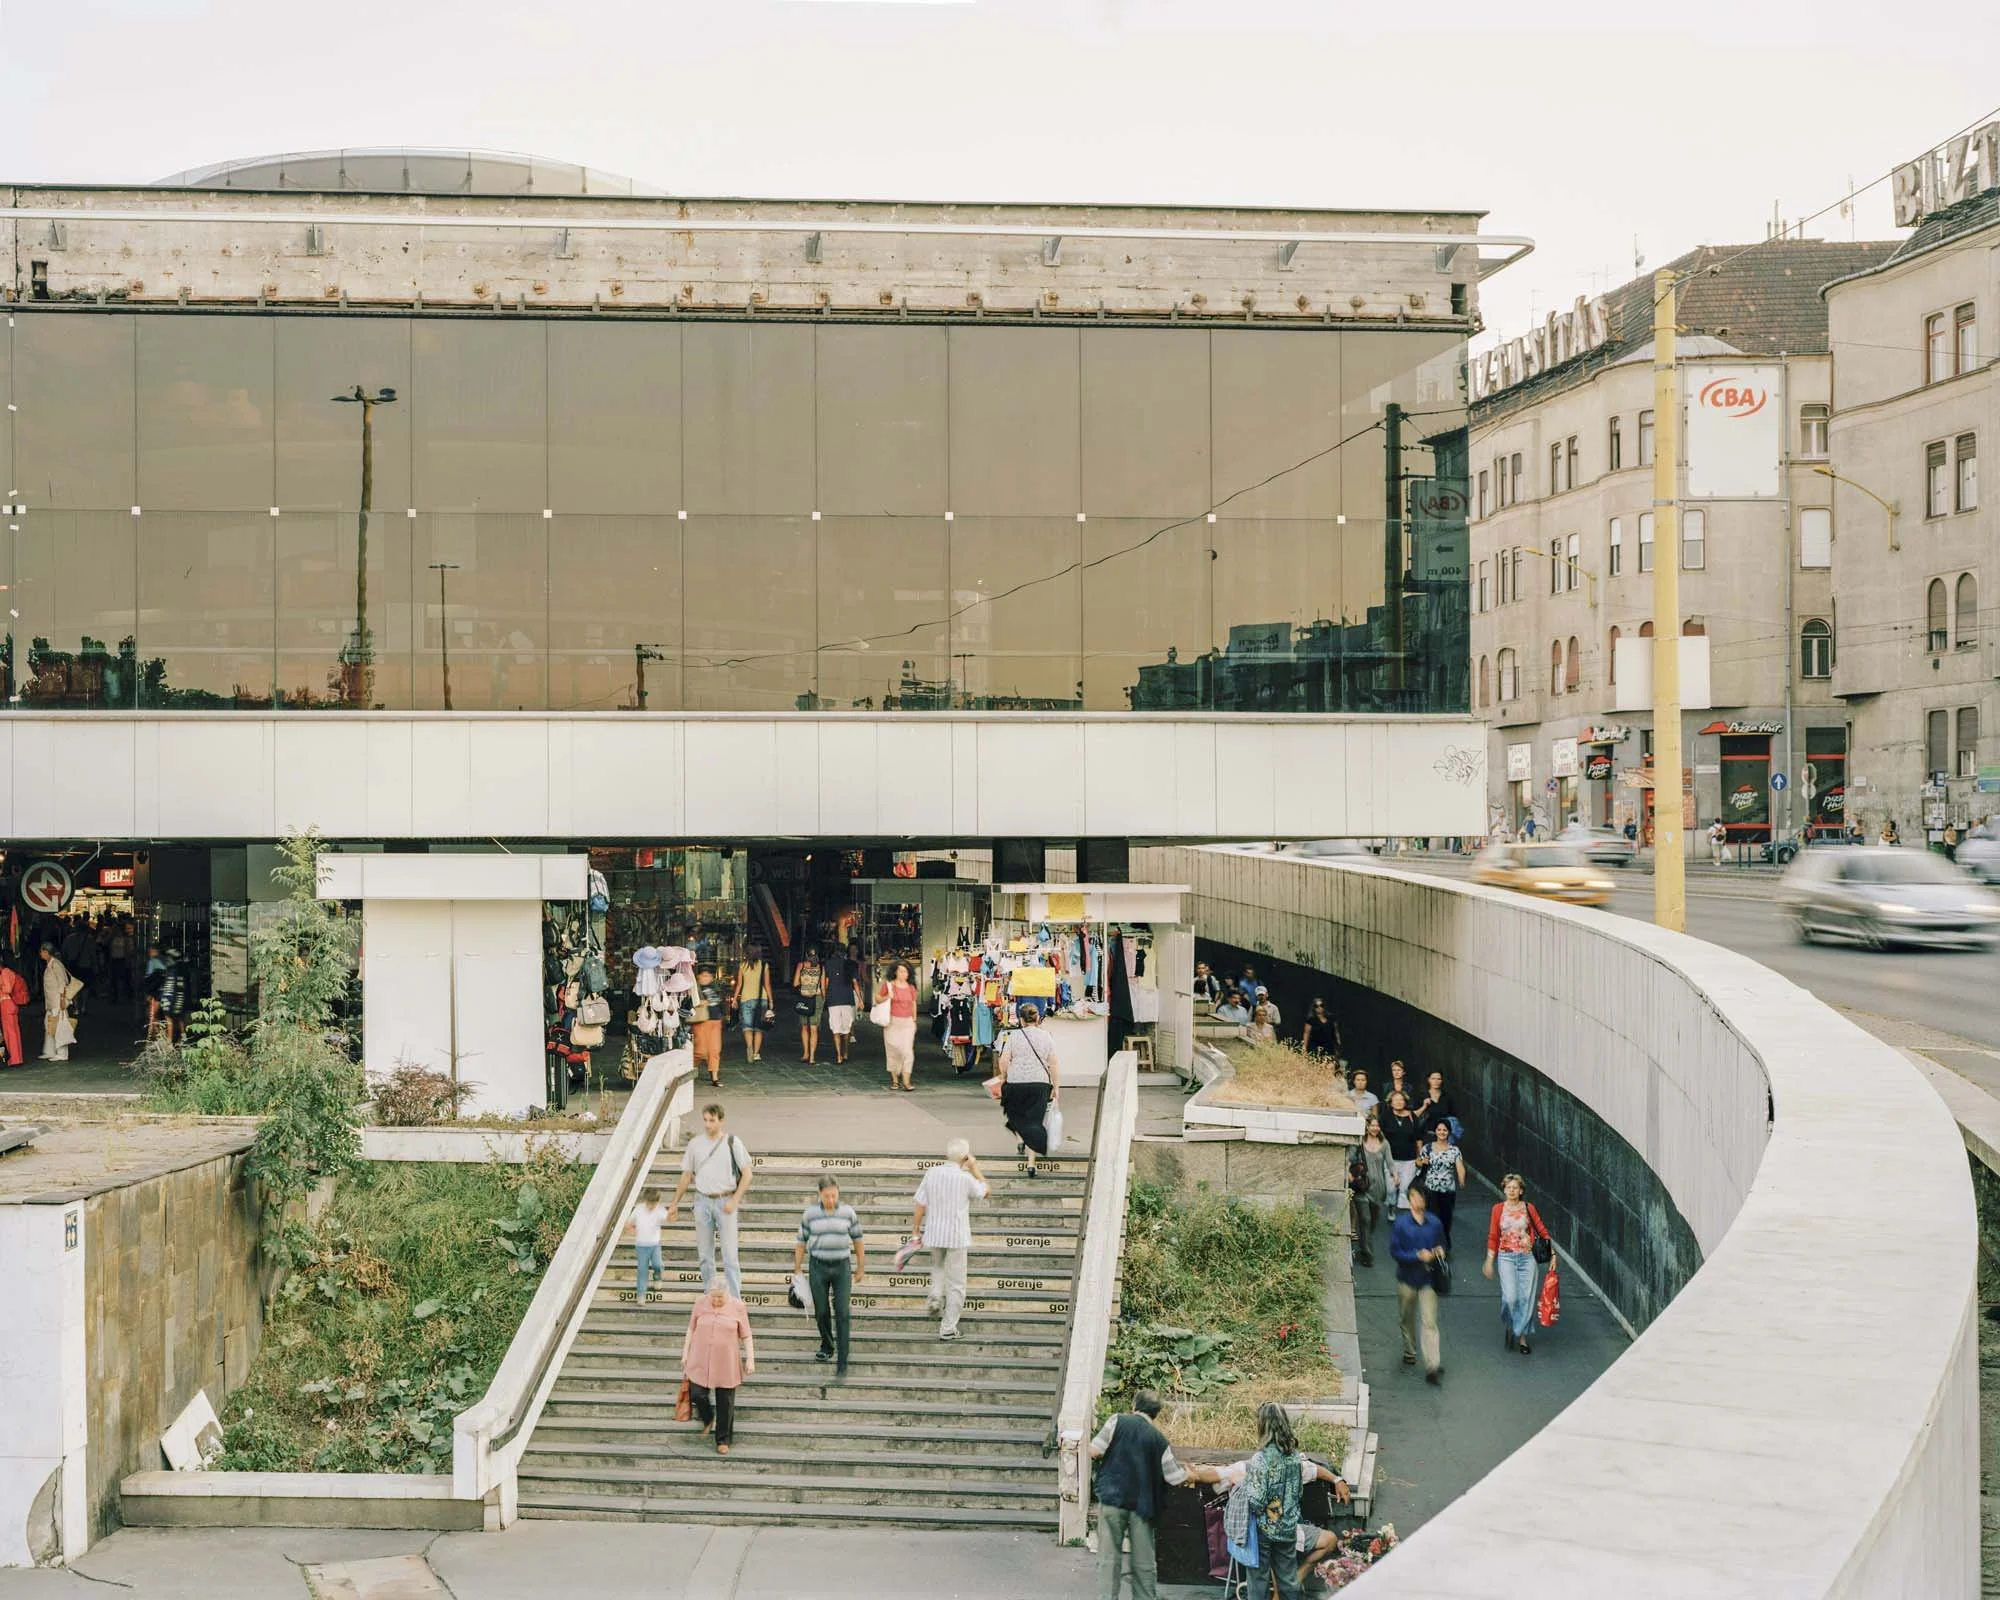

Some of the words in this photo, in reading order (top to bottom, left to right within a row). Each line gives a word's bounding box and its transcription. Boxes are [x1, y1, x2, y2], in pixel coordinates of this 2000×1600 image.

[1711, 388, 1755, 407] CBA
[1728, 722, 1759, 733] Pizza
[1759, 721, 1783, 734] Hut
[1730, 792, 1758, 804] Pizza
[1735, 798, 1755, 809] Hut
[821, 1157, 862, 1168] gorenje
[1018, 1162, 1060, 1171] goenje
[1006, 1237, 1051, 1248] gorenje
[997, 1279, 1043, 1290] gorenje
